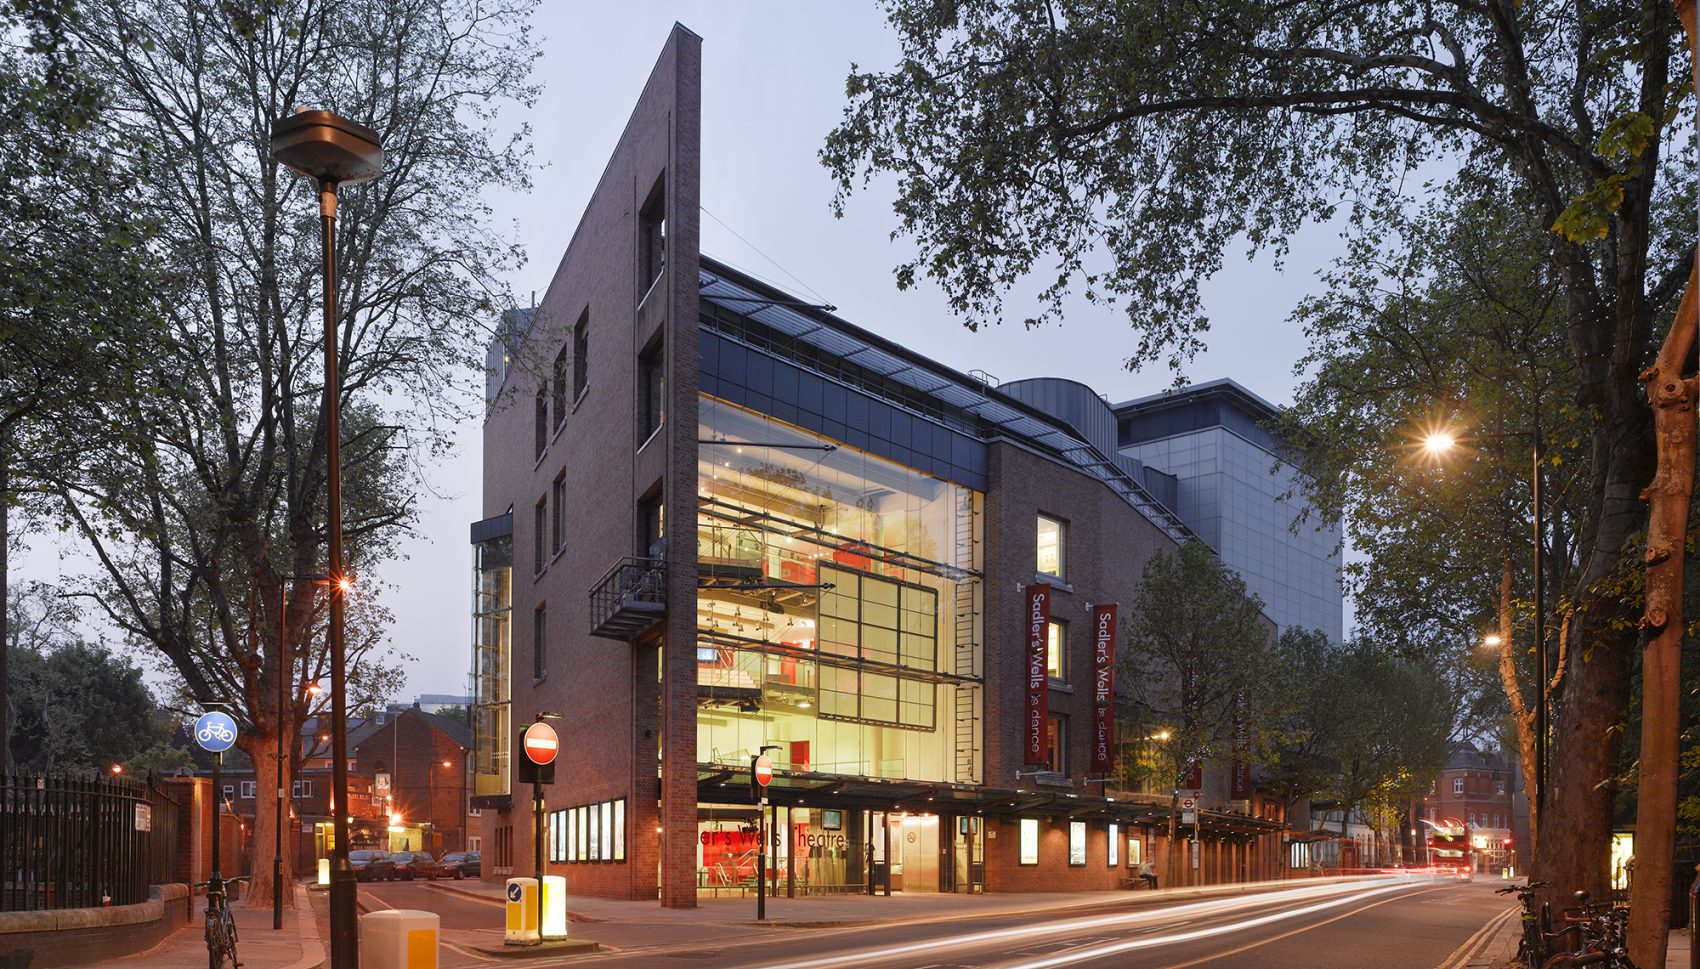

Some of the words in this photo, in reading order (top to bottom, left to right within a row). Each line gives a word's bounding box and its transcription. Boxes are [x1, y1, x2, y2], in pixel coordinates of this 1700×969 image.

[1031, 593, 1045, 648] Sadler's
[1097, 612, 1111, 663] Sadler's
[1030, 650, 1044, 689] Wells
[1096, 667, 1109, 701] Wells
[1031, 694, 1042, 706] is
[1031, 709, 1042, 753] dance
[794, 823, 845, 848] heatre
